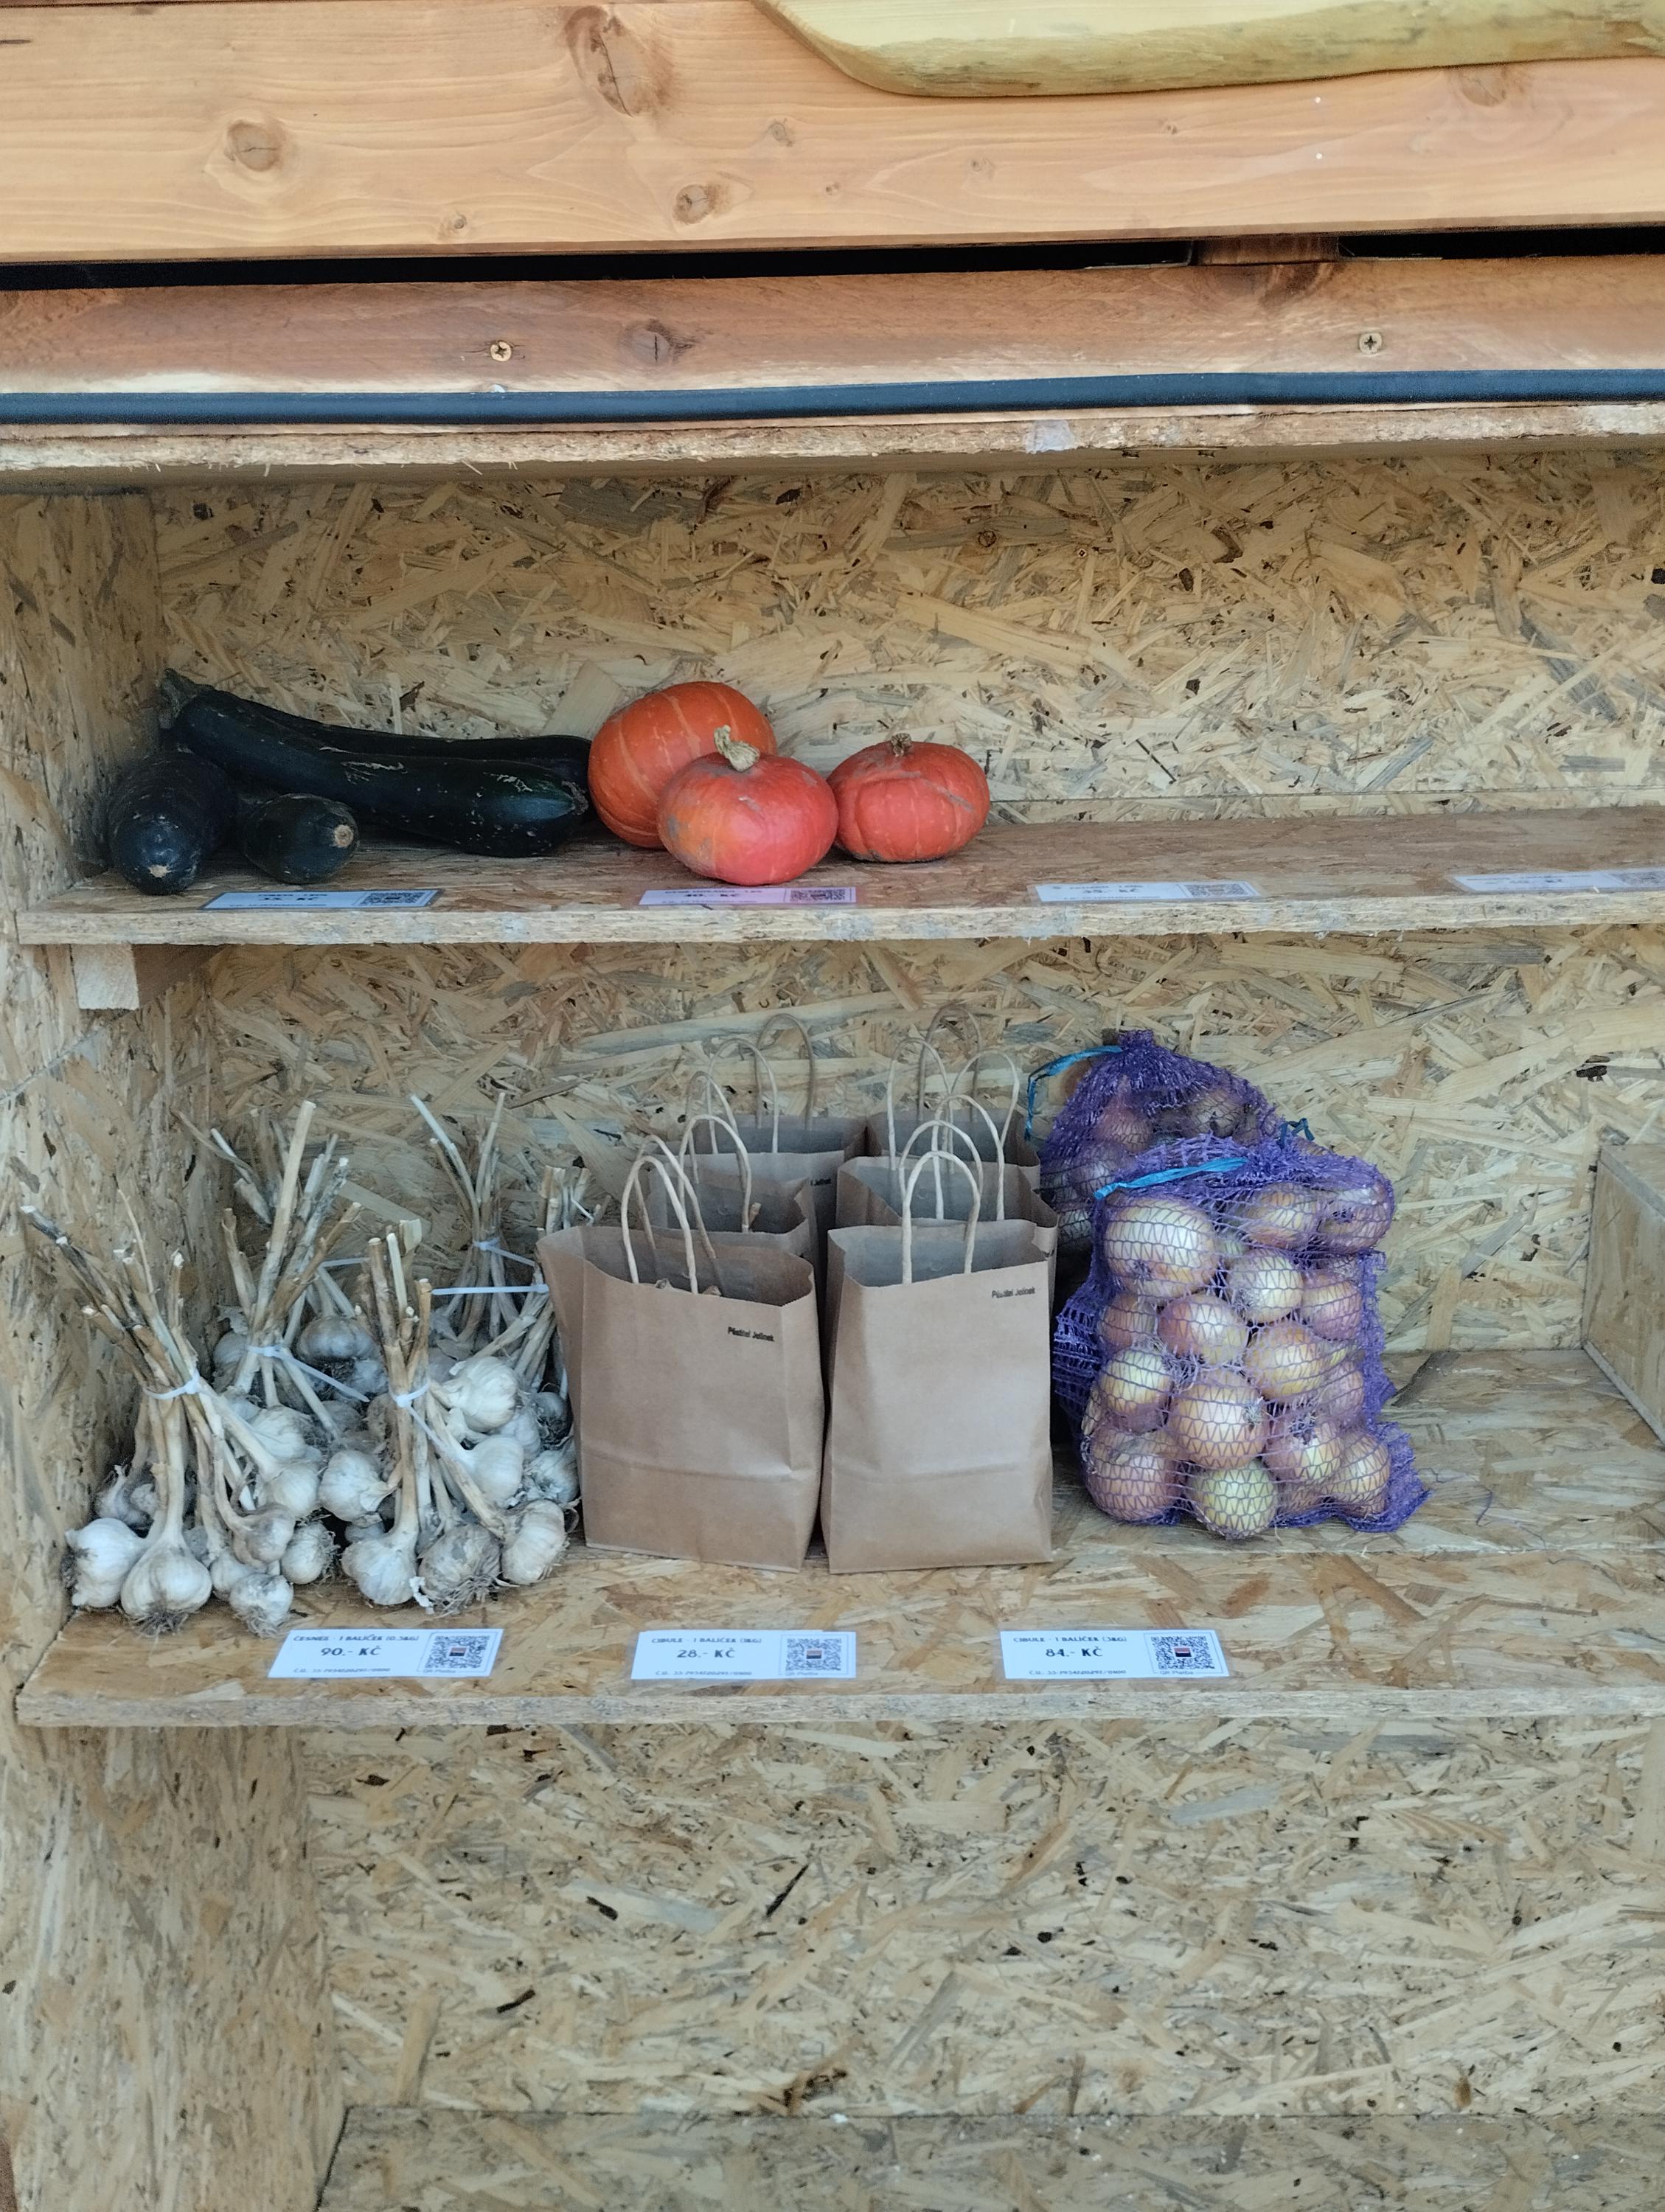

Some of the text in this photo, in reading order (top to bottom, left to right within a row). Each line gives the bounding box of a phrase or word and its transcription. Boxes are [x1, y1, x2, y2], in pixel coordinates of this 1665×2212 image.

[320, 1645, 382, 1656] 90.- KČ
[676, 1647, 736, 1658] 28.- KČ
[1046, 1646, 1103, 1658] 84.- KČ
